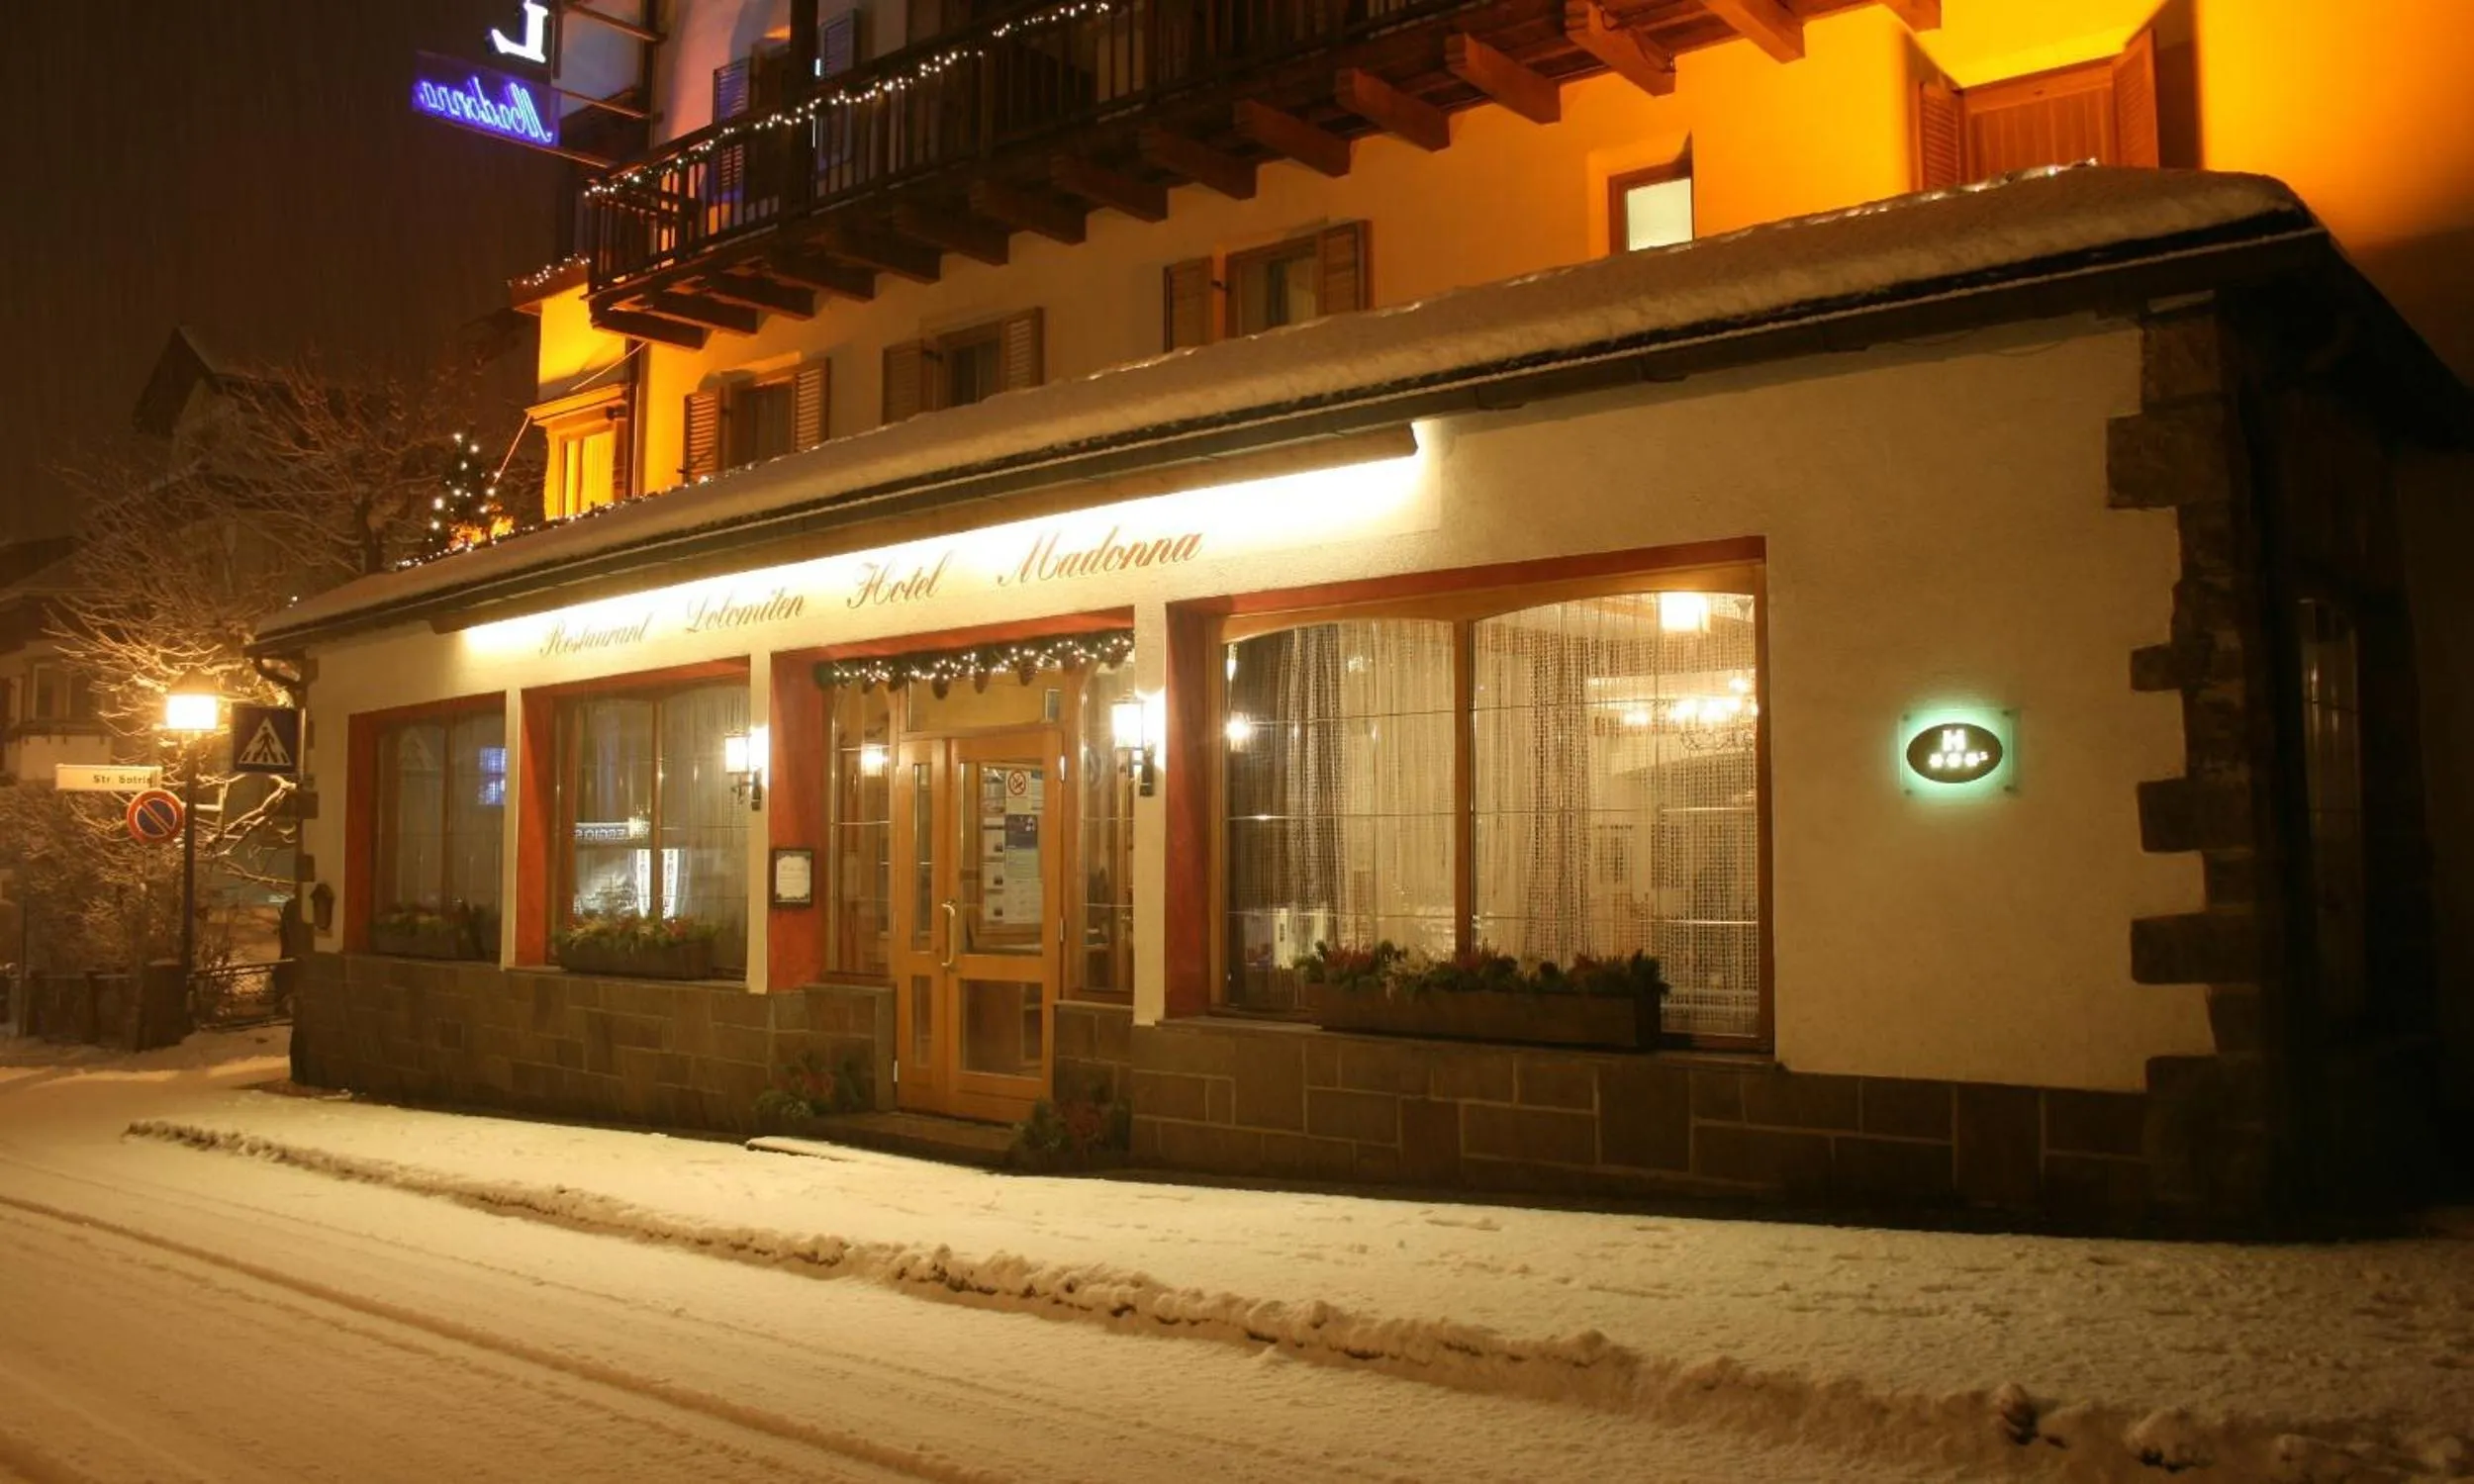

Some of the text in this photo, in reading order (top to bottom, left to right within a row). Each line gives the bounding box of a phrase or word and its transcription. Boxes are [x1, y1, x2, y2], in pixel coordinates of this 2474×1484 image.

[539, 522, 1207, 657] Restaurant Dolomiten Hotel Madonna
